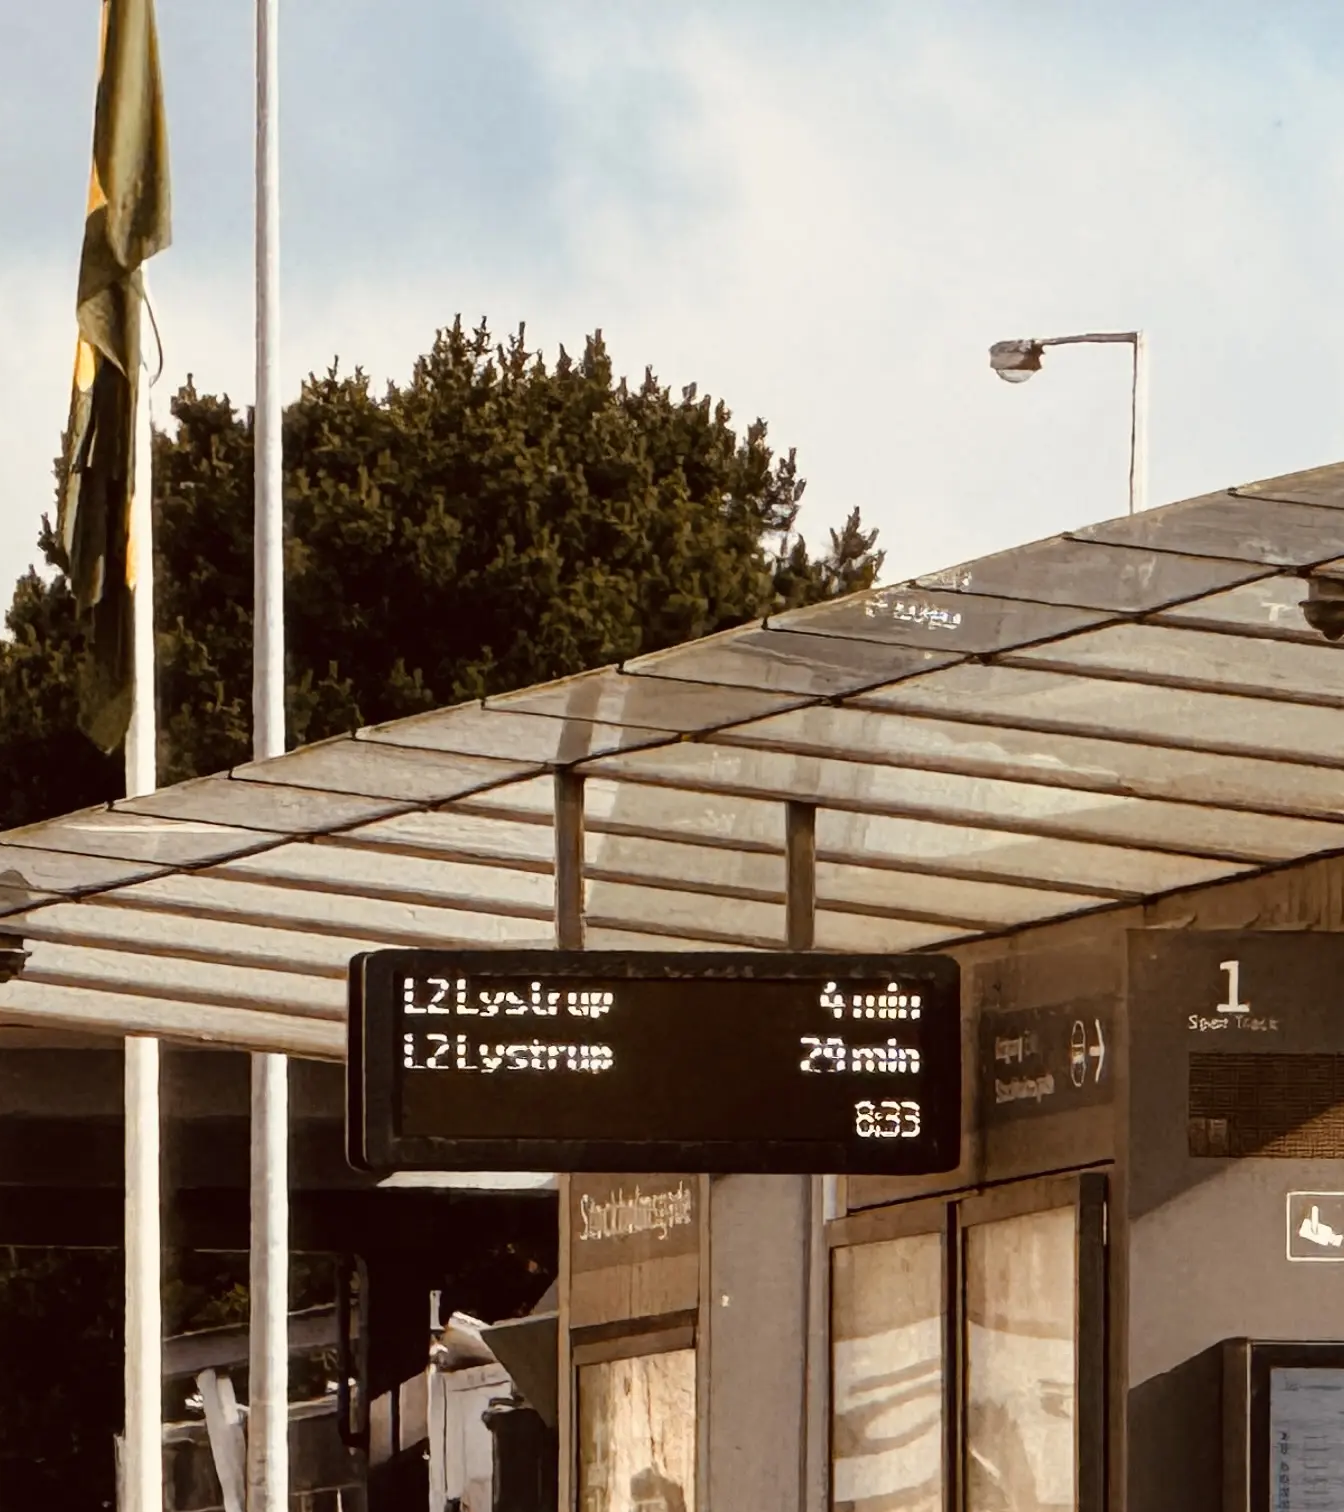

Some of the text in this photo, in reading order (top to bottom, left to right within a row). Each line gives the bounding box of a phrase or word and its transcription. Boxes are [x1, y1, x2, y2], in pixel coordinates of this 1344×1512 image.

[819, 981, 847, 1019] 4
[851, 981, 922, 1020] min
[1216, 959, 1251, 1013] 1
[851, 1037, 922, 1074] min
